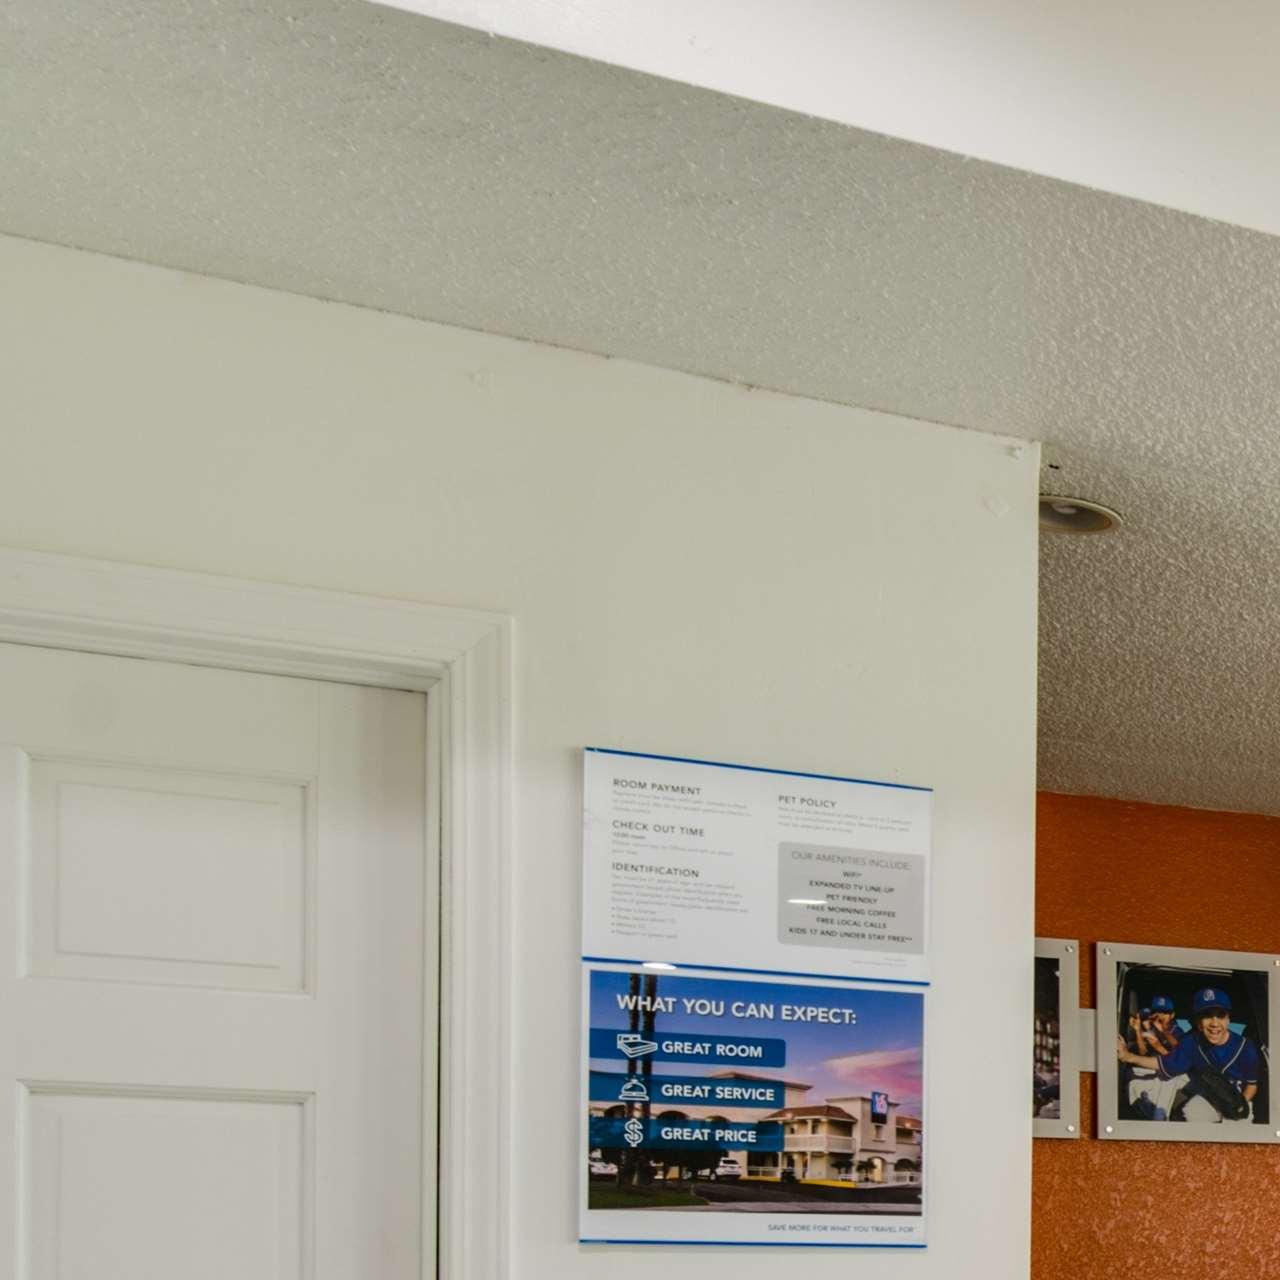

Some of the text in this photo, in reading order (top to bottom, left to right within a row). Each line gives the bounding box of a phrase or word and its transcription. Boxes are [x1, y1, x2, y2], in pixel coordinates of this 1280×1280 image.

[613, 778, 702, 795] ROOM PAYMENT
[778, 795, 838, 808] PET POLICY
[612, 820, 704, 837] CHECK OUT TIME
[791, 851, 813, 860] OUR
[816, 853, 866, 866] AMENITIES
[612, 862, 699, 878] IDENTIFICATION
[809, 880, 851, 890] EXPANDED
[842, 894, 878, 904] FRIENDLY
[827, 906, 866, 916] MORNING
[867, 910, 896, 918] COFFEE
[816, 917, 887, 929] FREE LOCAL CALLS
[788, 927, 807, 935] KIDS
[840, 931, 866, 939] UNDER
[868, 933, 886, 941] STAY
[616, 994, 857, 1025] WHAT YOU CAN EXPECT:
[662, 1041, 763, 1058] GREAT ROOM
[661, 1084, 775, 1101] GREAT SERVICE
[661, 1127, 757, 1143] GREAT PRICE
[813, 1224, 827, 1232] FOR
[871, 1225, 896, 1233] TRAVEL
[899, 1225, 914, 1233] FOR
